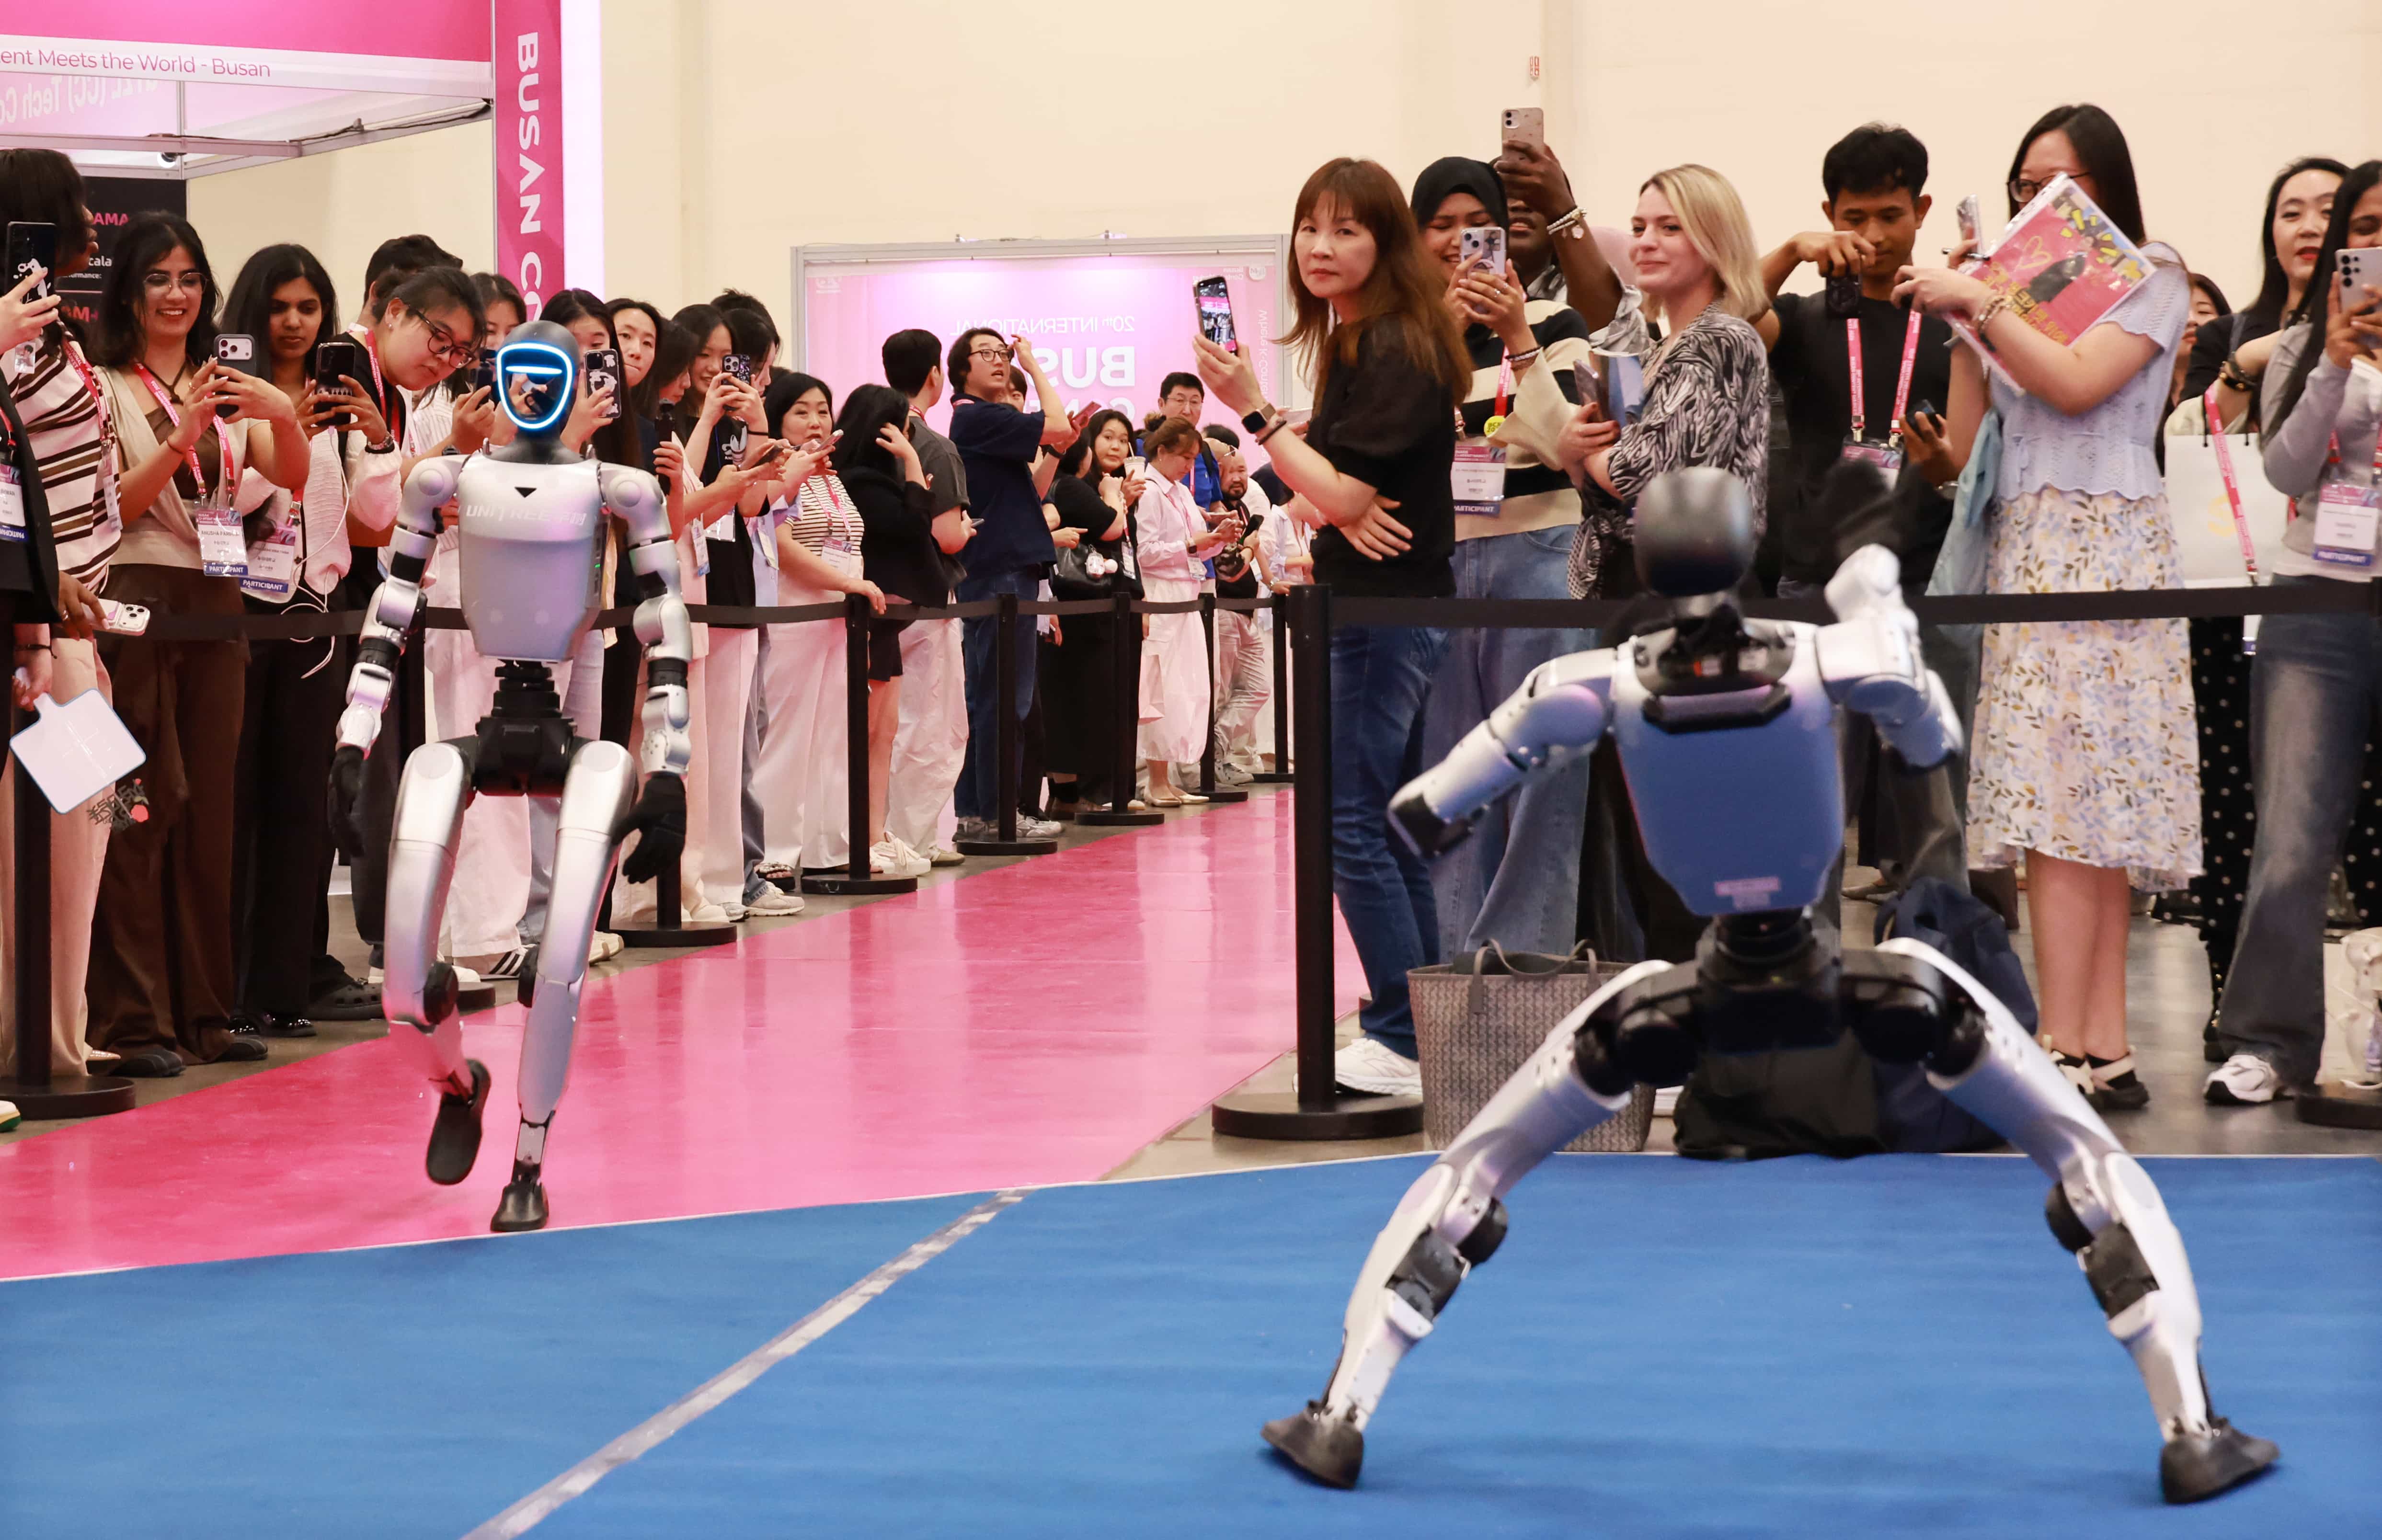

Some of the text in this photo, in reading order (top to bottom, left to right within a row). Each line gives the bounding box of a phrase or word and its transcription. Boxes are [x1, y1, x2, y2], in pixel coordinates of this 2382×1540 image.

[0, 50, 33, 66] ent
[38, 49, 97, 68] Meets
[101, 52, 134, 71] the
[138, 54, 195, 73] World
[212, 58, 271, 78] Busan
[517, 32, 545, 234] BUSAN
